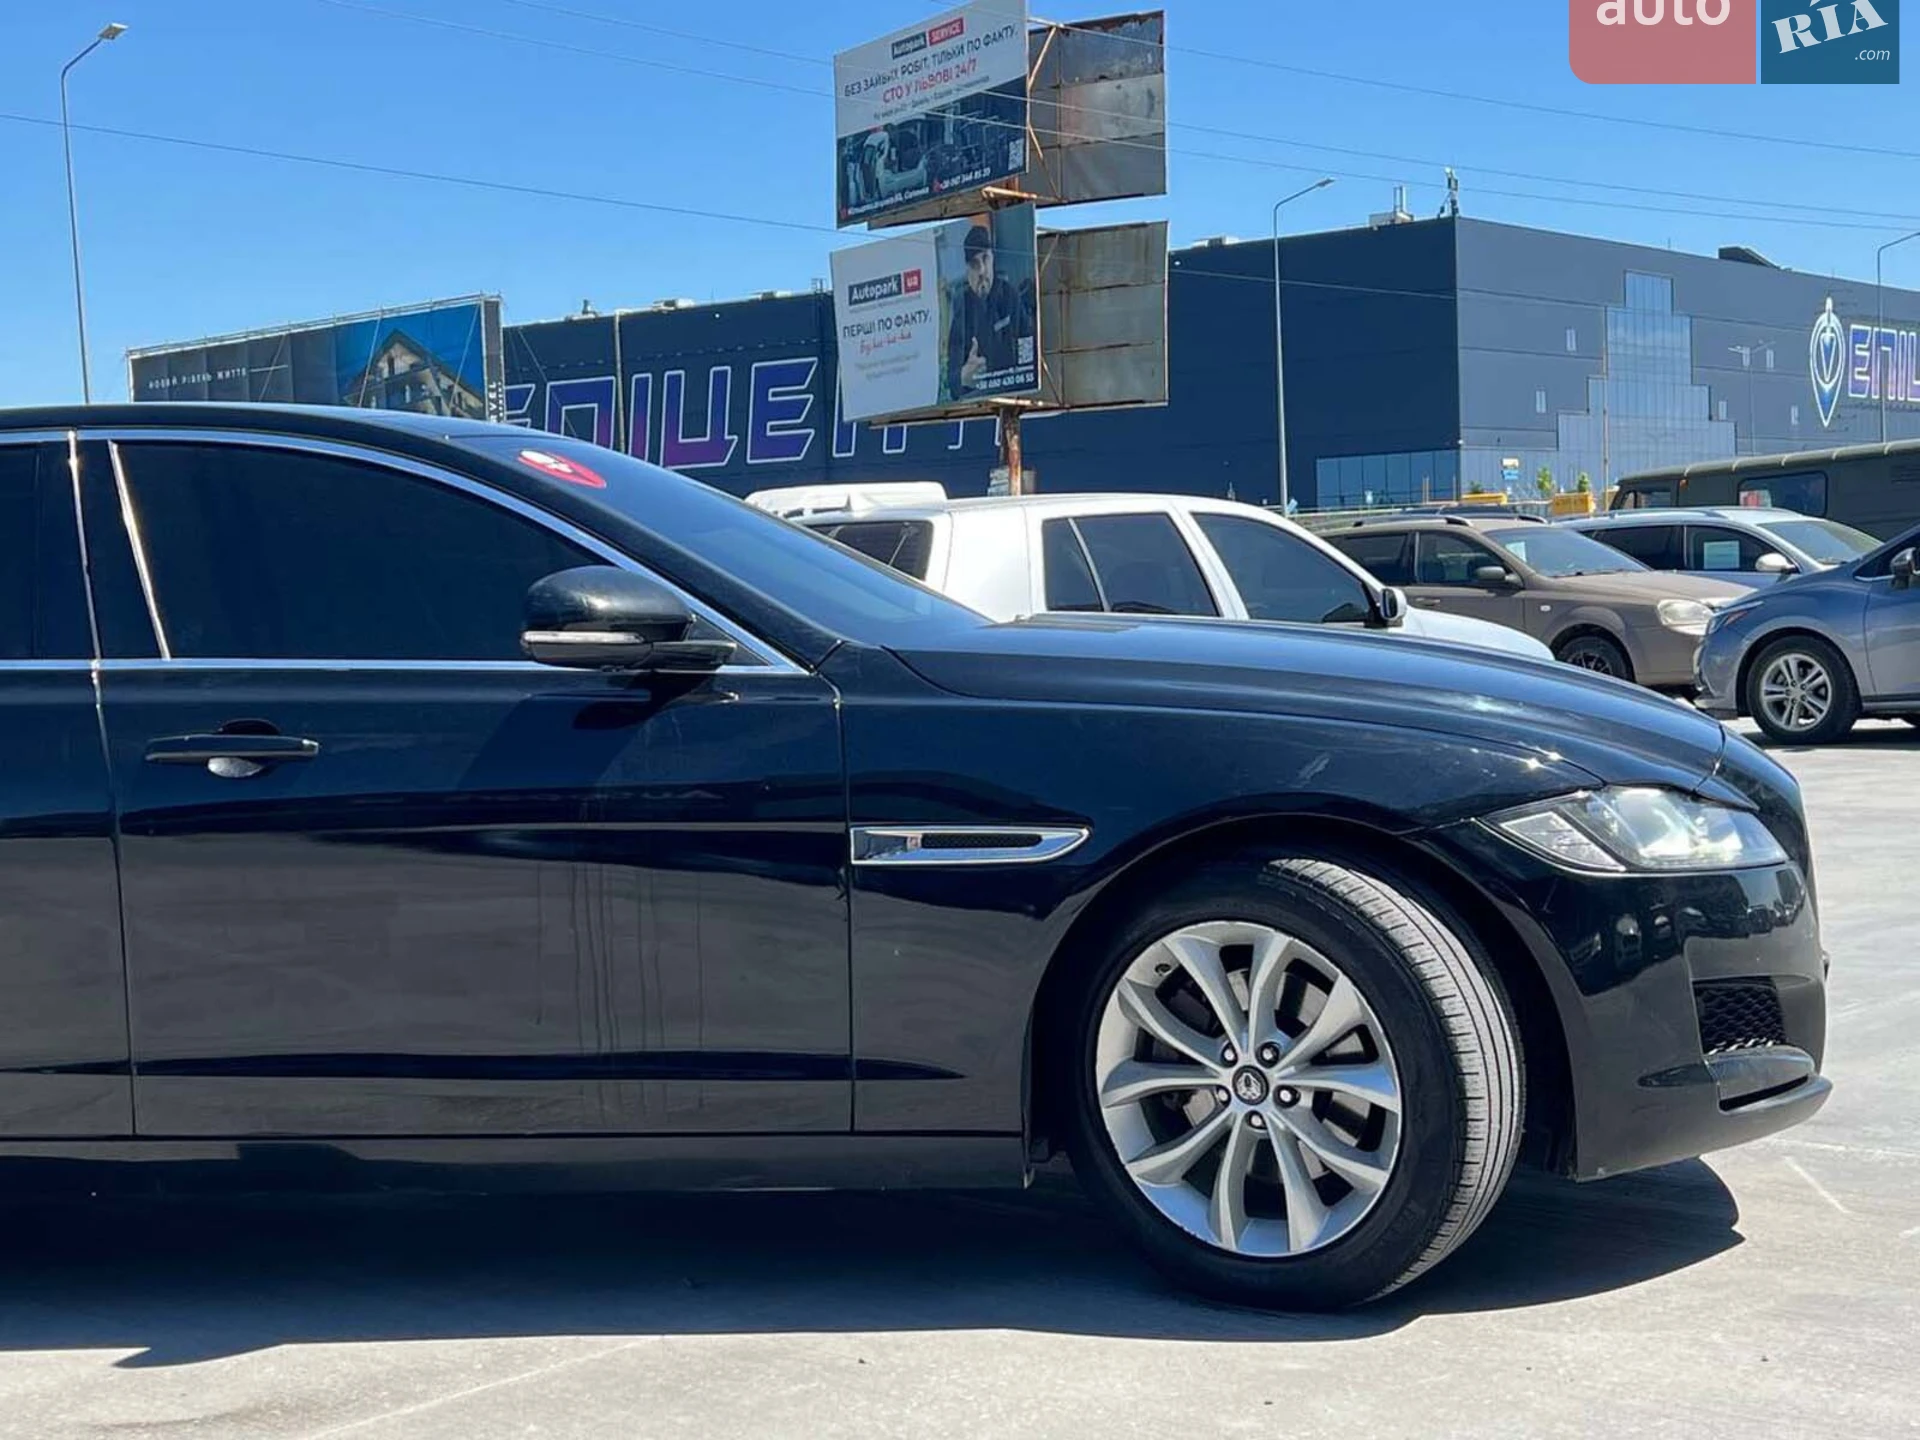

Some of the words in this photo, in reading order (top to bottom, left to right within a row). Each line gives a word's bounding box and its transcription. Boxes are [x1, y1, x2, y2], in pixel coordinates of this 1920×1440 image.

[930, 22, 961, 44] SERVICE
[844, 80, 862, 97] БЕЗ
[932, 45, 965, 66] ТІЛЬКИ
[966, 37, 981, 53] ПО
[883, 84, 905, 103] СТО
[914, 68, 953, 94] ЛЬВОВІ
[955, 57, 977, 80] 24/7
[851, 276, 899, 300] Autopark
[906, 276, 919, 288] ua
[843, 320, 876, 338] ПЕРШІ
[878, 317, 893, 331] ПО
